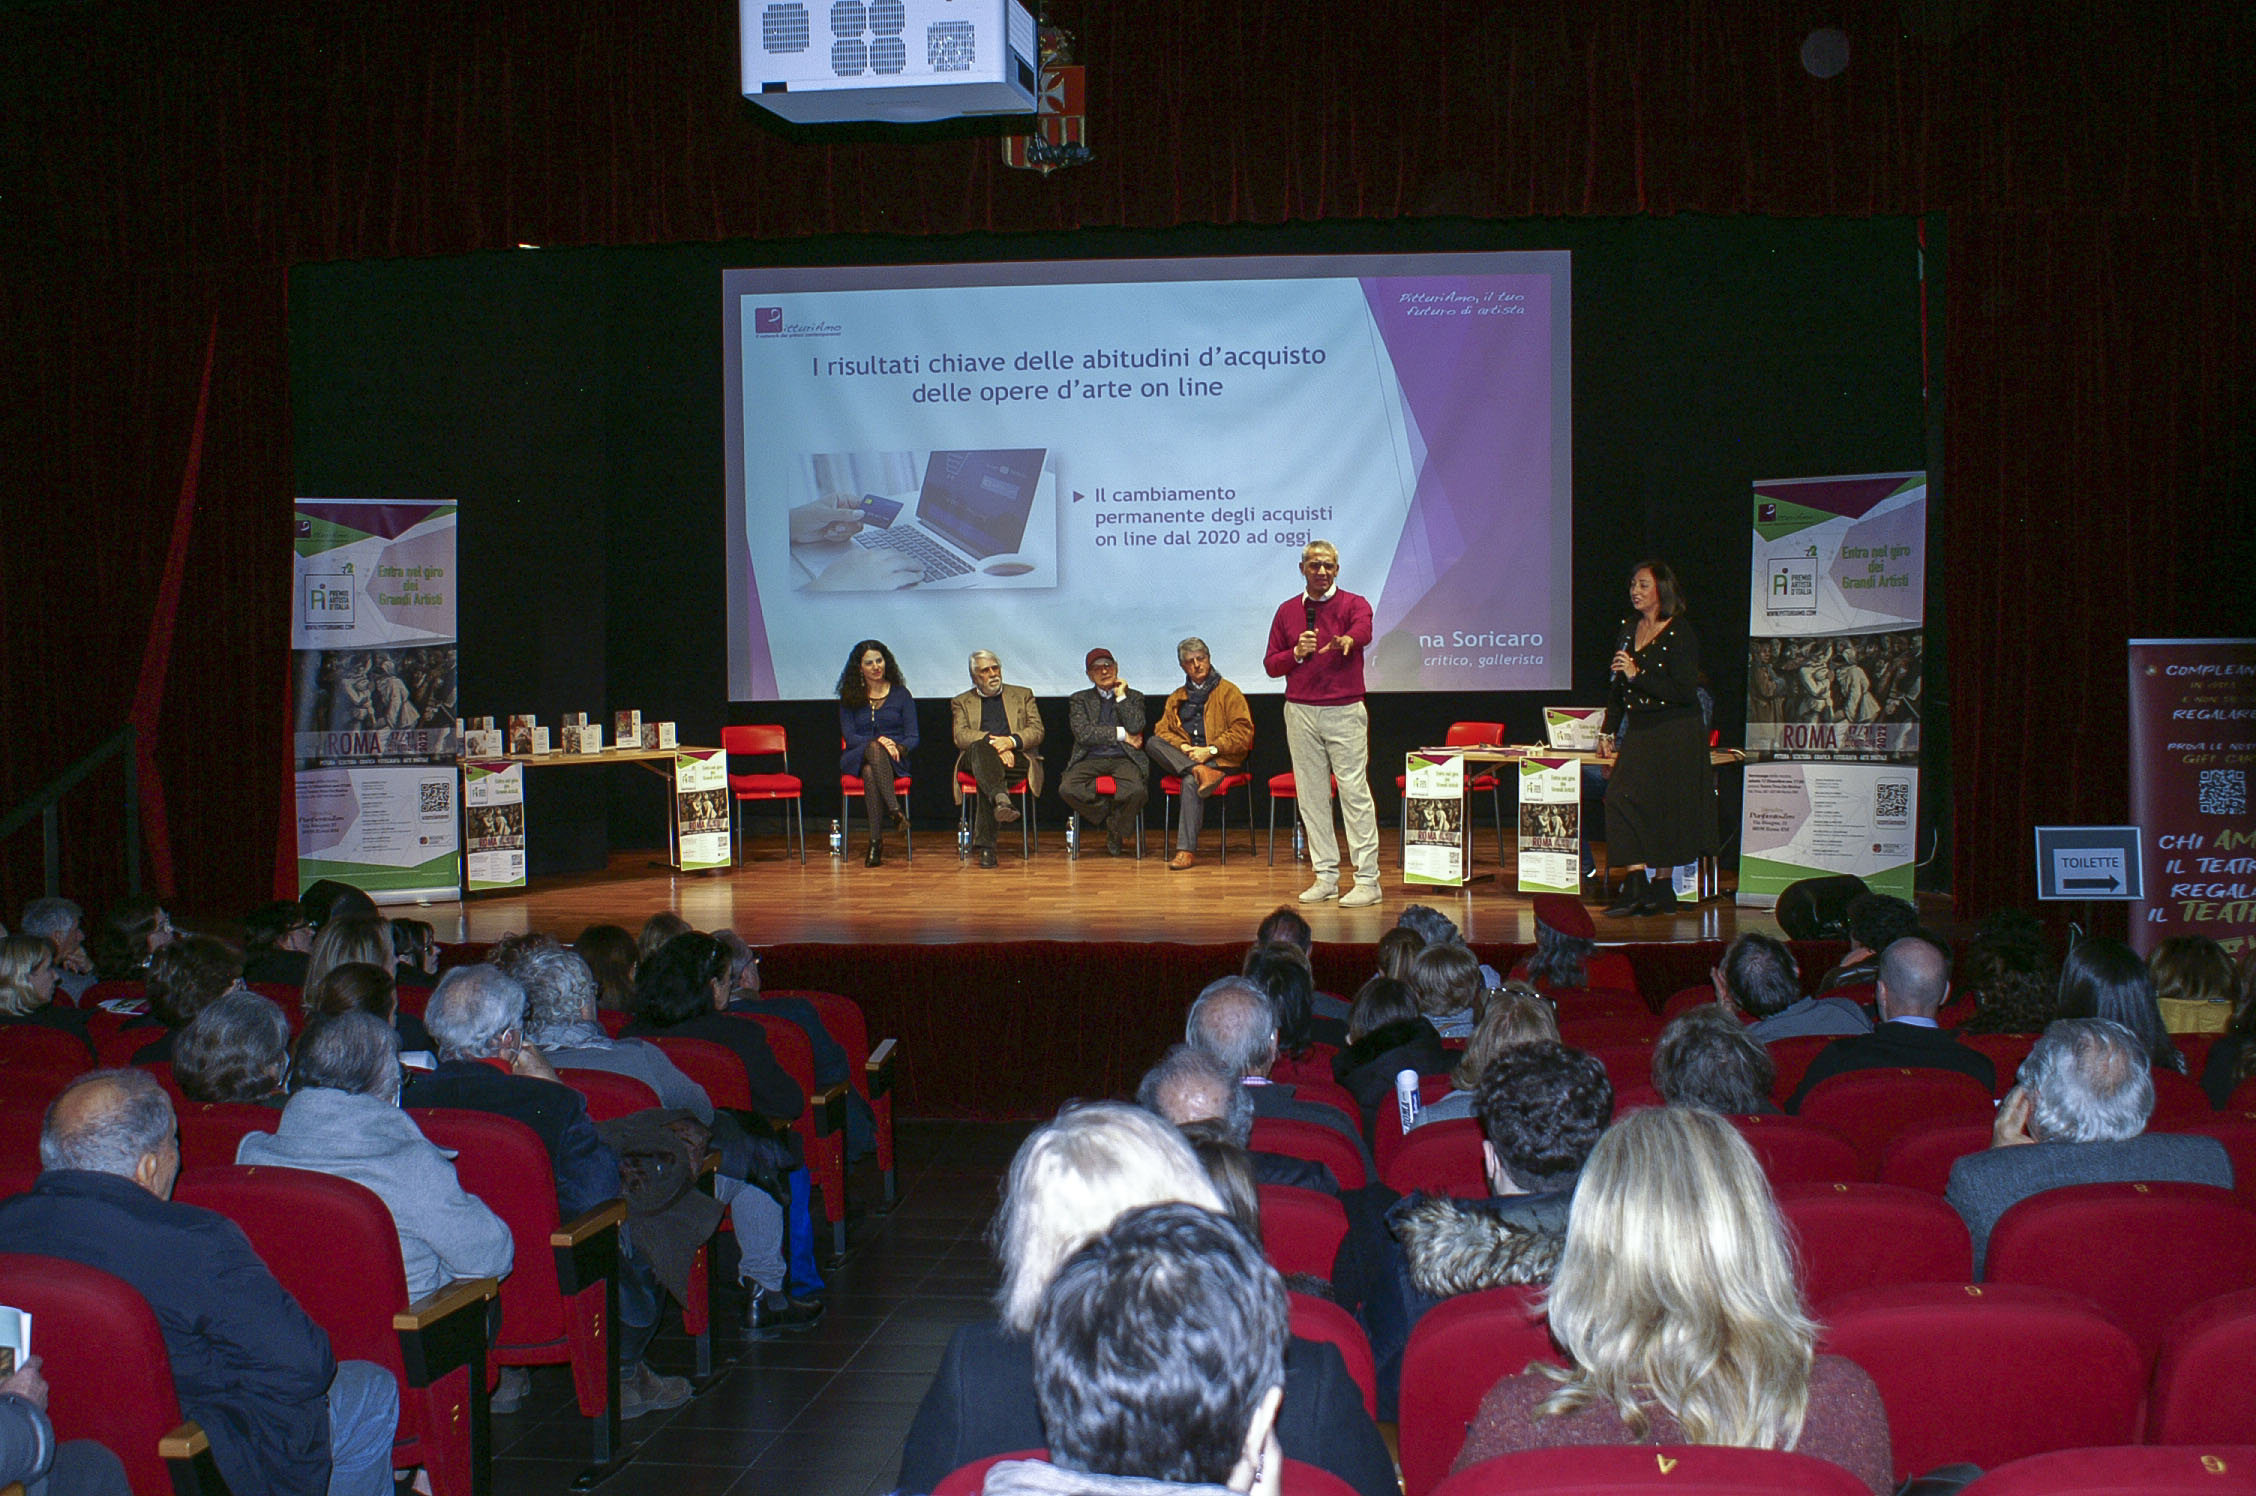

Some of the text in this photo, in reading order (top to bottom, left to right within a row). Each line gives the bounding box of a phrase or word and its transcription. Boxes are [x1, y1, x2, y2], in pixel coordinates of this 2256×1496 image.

[1407, 304, 1526, 316] futuro di artista
[812, 346, 1327, 377] I risultati chiave delle abitudini d’acquisto
[912, 377, 1224, 405] delle opere d’arte on line
[1095, 487, 1236, 503] Il cambiamento
[1095, 506, 1333, 528] permanente degli acquisti
[1095, 528, 1312, 548] on line dal 2020 ad oggi
[1842, 545, 1869, 560] Entra
[1890, 544, 1911, 560] giro
[1868, 560, 1884, 573] dei
[1842, 574, 1909, 589] Grandi Artisti
[1452, 630, 1543, 648] Soricaro
[1423, 653, 1544, 668] critico, gallerista
[328, 732, 382, 755] ROMA
[1783, 725, 1837, 749] ROMA
[2167, 742, 2206, 751] PROVA
[2158, 833, 2204, 850] CHI
[2061, 856, 2119, 869] TOILETTE
[2165, 859, 2186, 875] IL
[2147, 907, 2168, 923] IL
